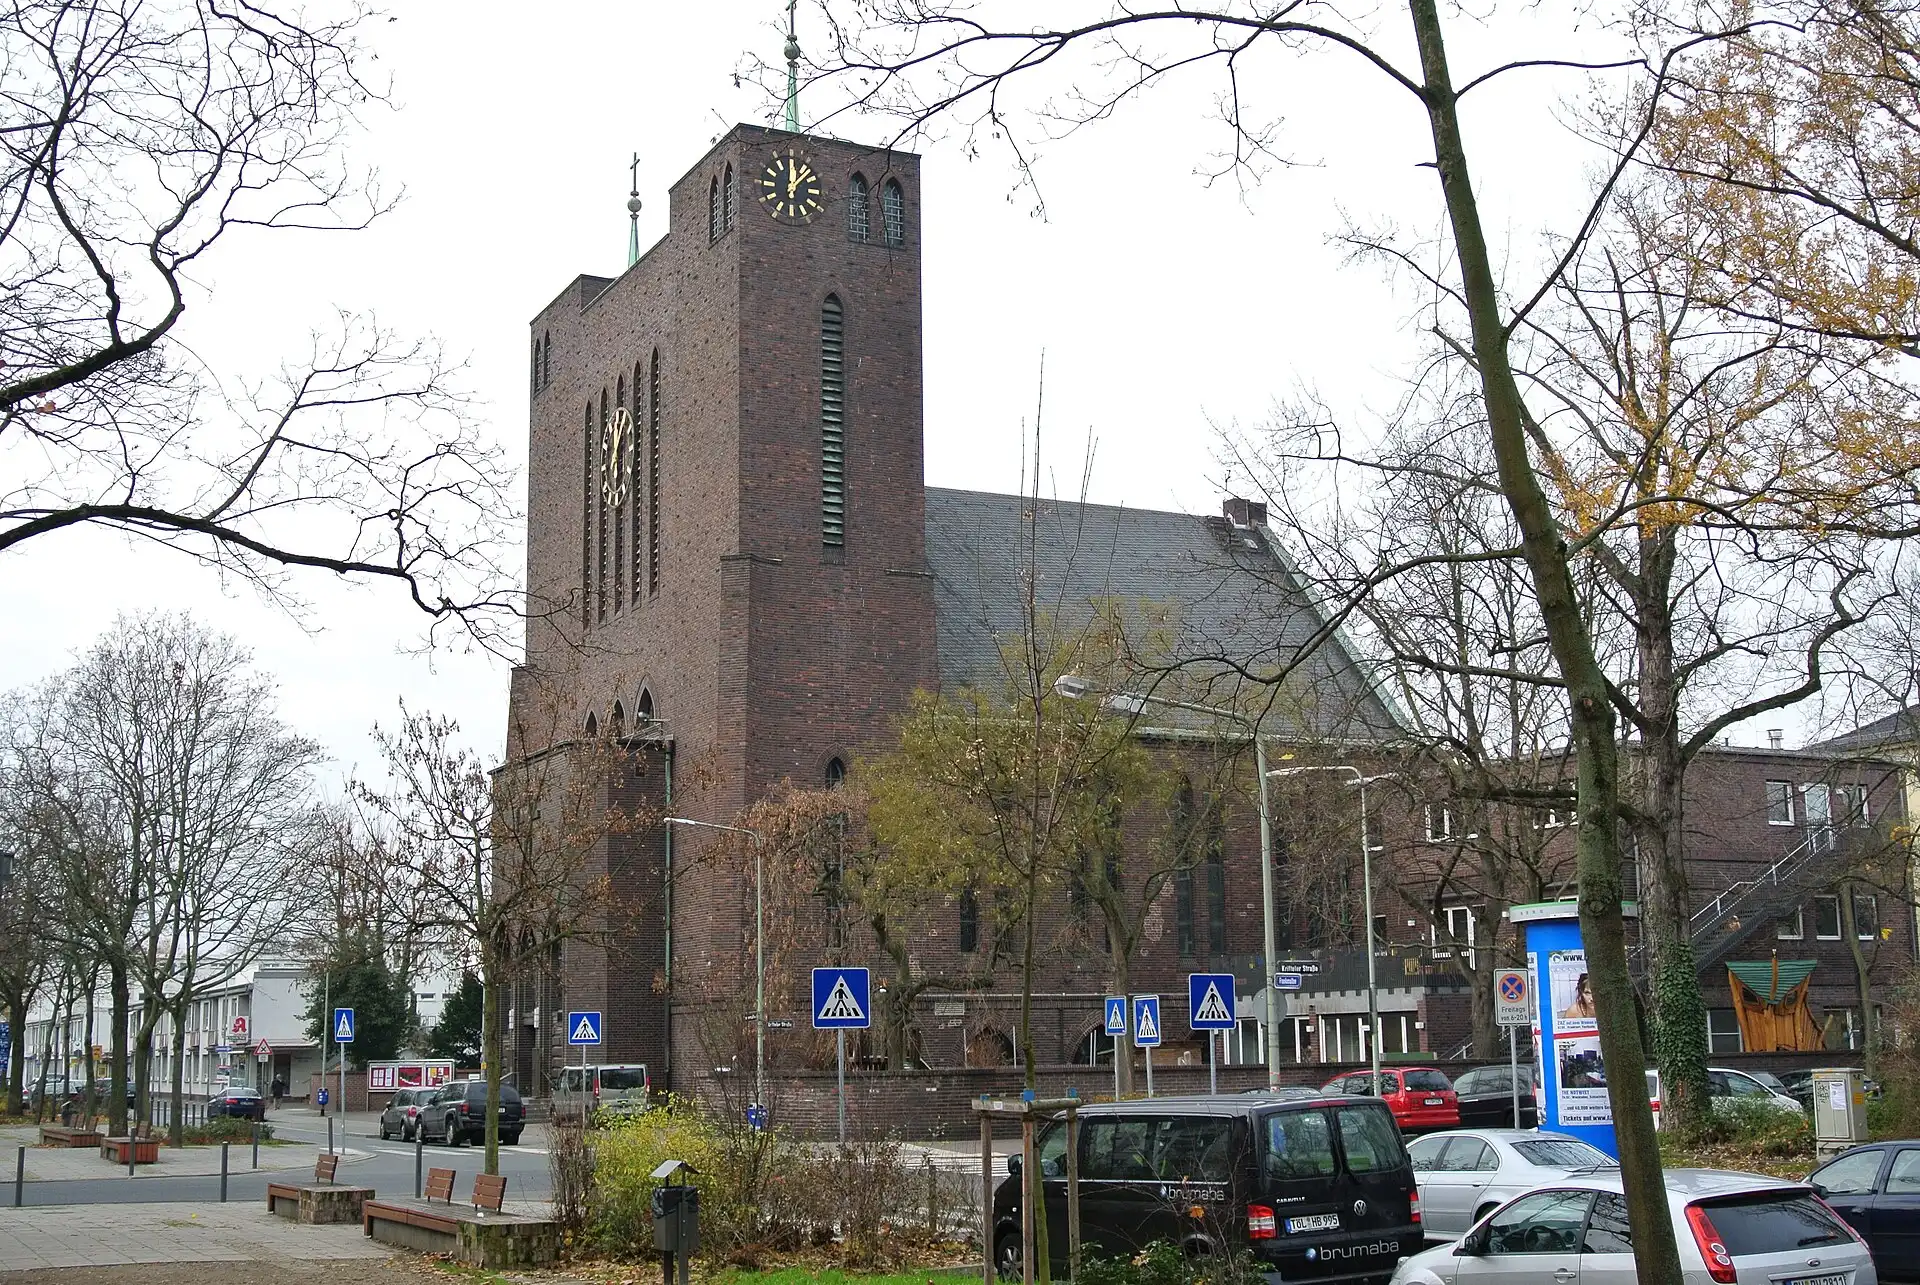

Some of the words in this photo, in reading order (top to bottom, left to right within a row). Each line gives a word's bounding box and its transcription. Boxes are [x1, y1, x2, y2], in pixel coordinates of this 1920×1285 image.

[1302, 964, 1319, 972] Straße
[1169, 1185, 1225, 1201] brumaba
[1276, 1196, 1306, 1204] CARAVELLE
[1311, 1216, 1322, 1228] HB
[1323, 1214, 1338, 1226] 995
[1320, 1240, 1400, 1260] brumaba
